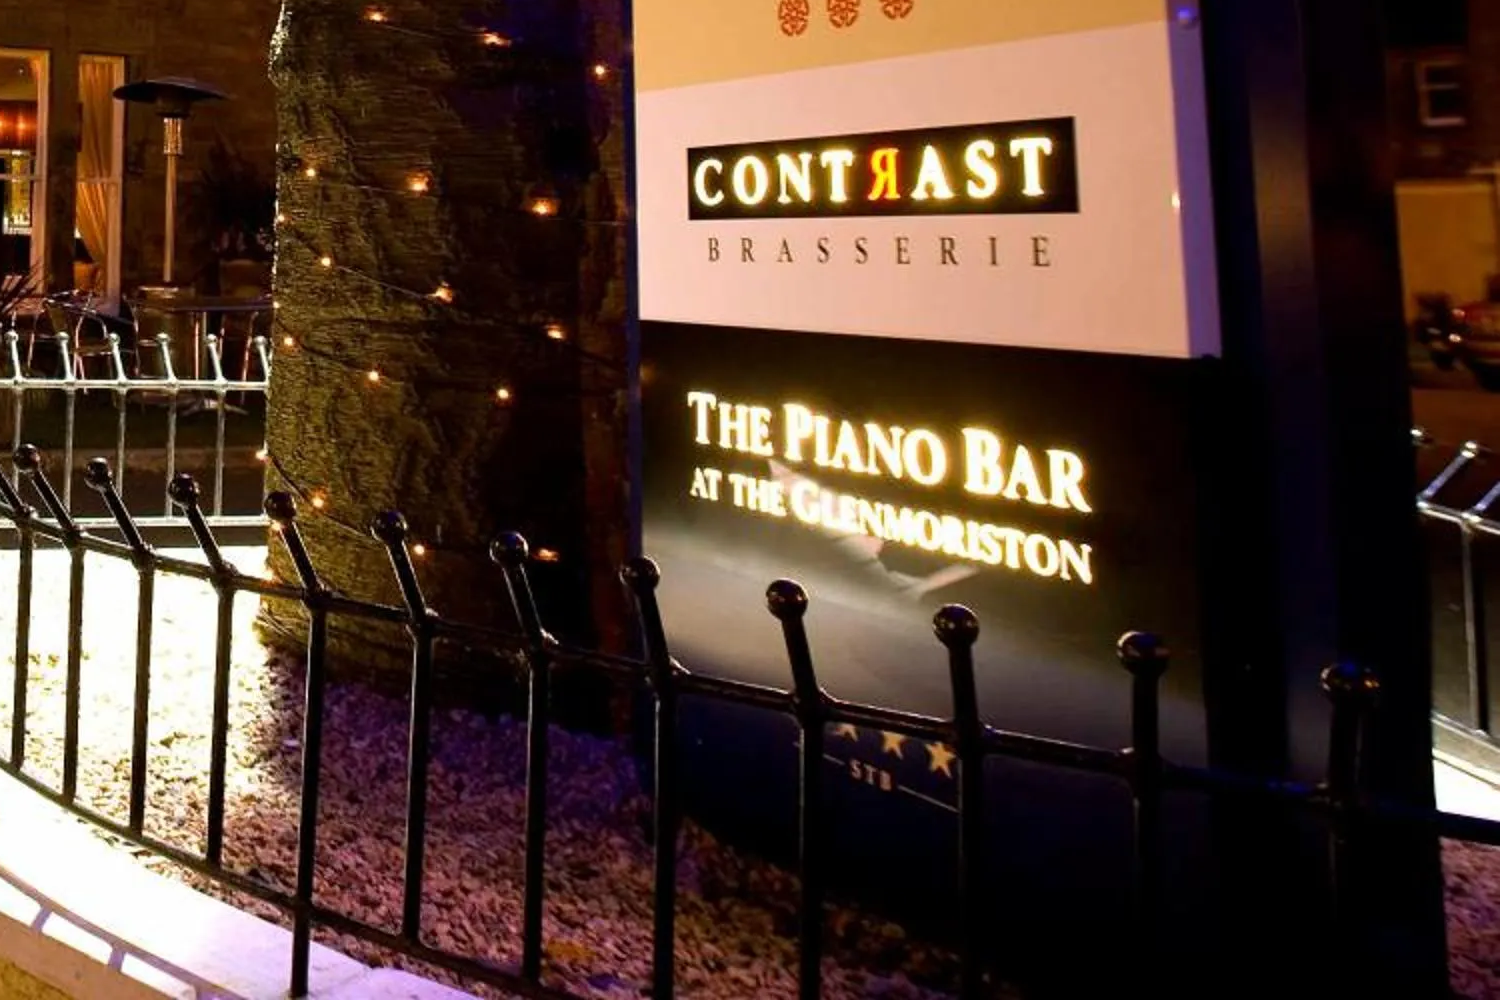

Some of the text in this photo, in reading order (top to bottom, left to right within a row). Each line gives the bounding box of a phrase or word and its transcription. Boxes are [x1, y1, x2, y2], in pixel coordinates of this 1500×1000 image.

[708, 235, 1051, 268] BRASSERIE
[687, 390, 1094, 514] THE PIANO BAR
[689, 467, 1093, 585] AT THE GLENMORISTON
